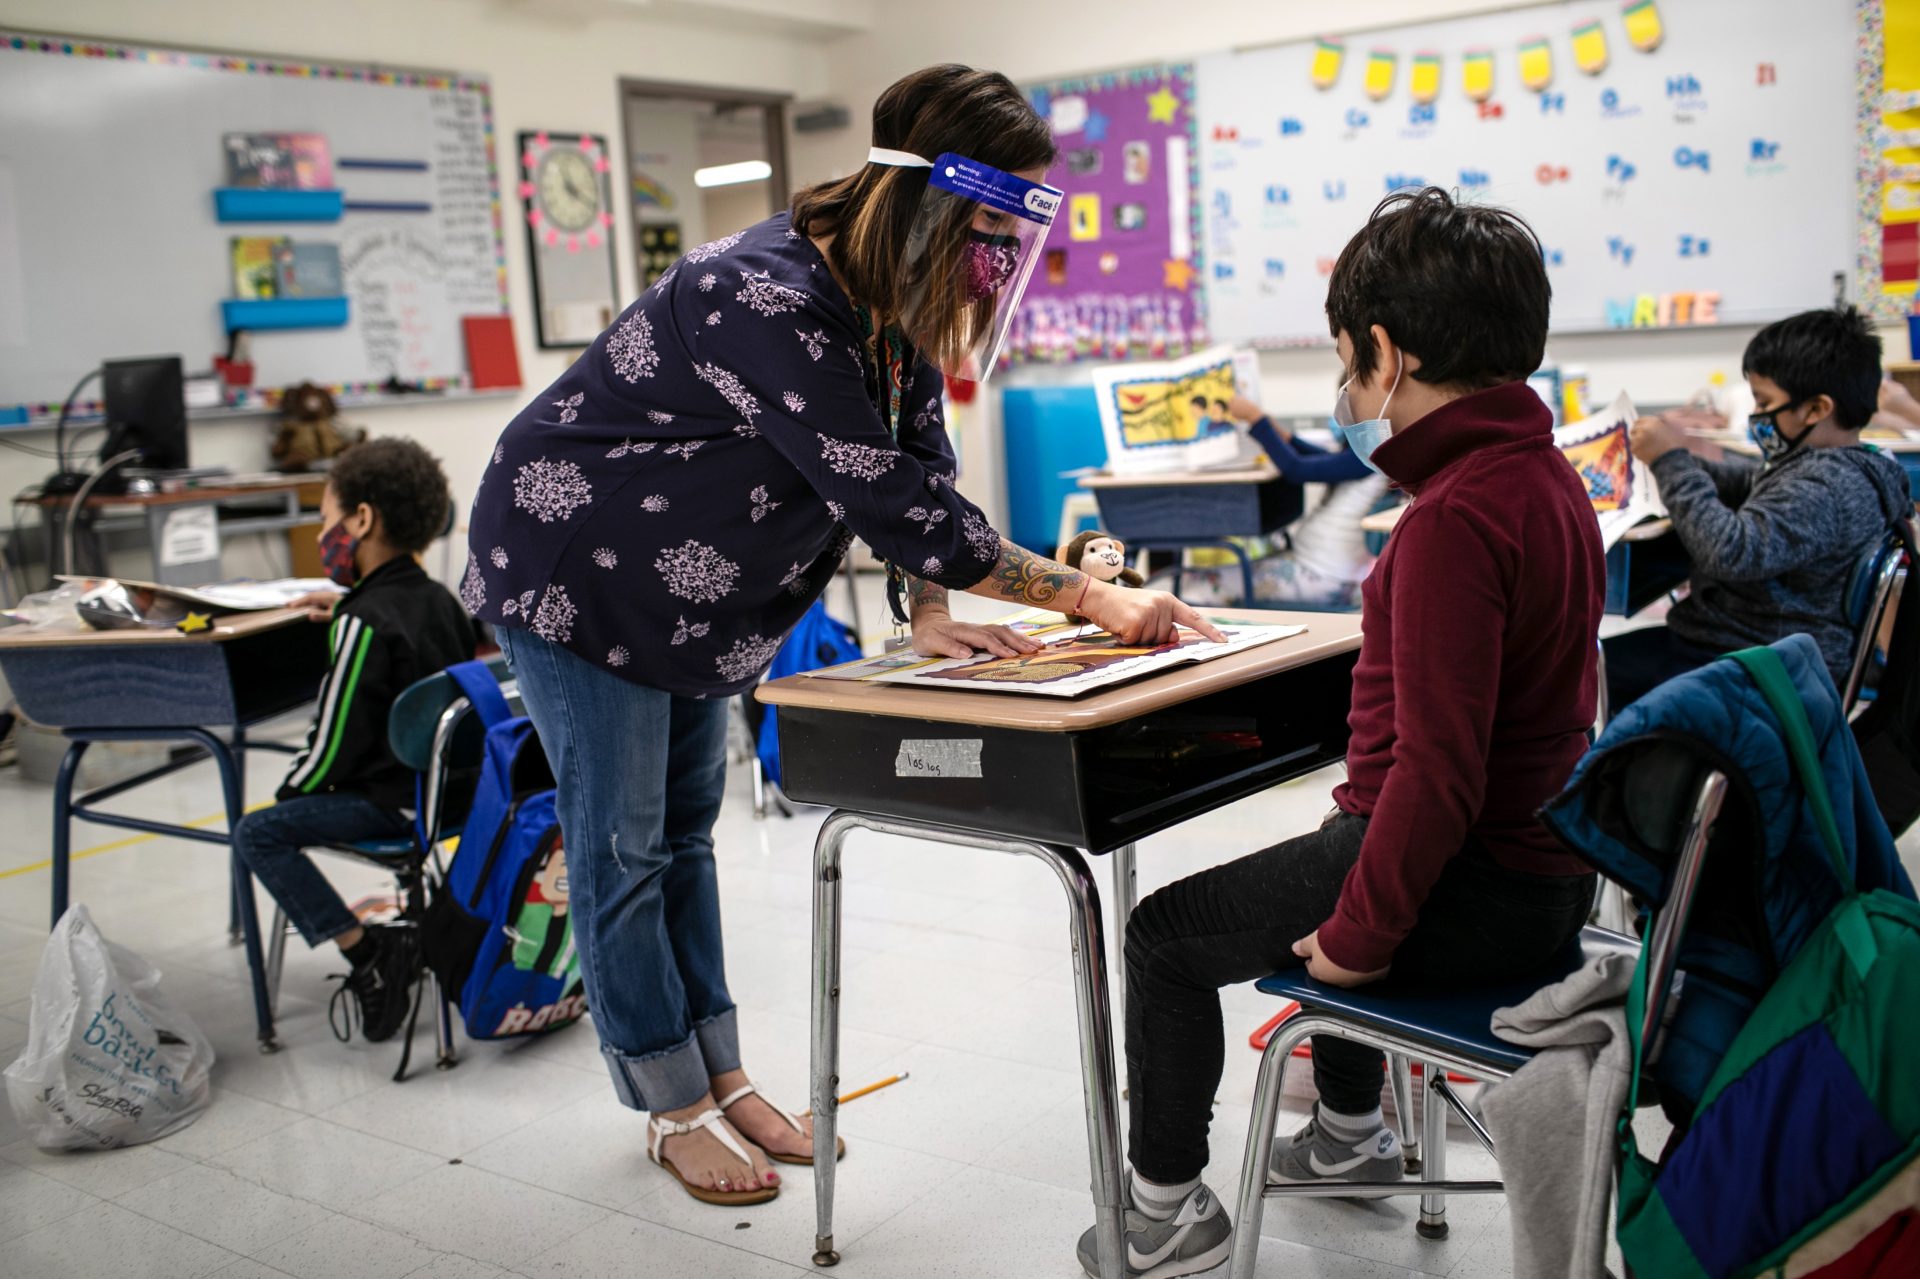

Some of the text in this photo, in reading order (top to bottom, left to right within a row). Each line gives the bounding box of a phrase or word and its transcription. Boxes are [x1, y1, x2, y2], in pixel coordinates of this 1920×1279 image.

[1666, 73, 1701, 97] Hh
[958, 163, 982, 177] Warning:
[1606, 155, 1636, 183] Pp
[1750, 138, 1780, 162] Rr
[957, 182, 976, 191] prevent
[975, 179, 987, 187] used
[1030, 194, 1053, 211] Face
[1607, 236, 1635, 266] Yy
[1605, 290, 1721, 328] WRITE
[77, 1084, 143, 1119] ShopRite
[1194, 1187, 1208, 1208] NIKE
